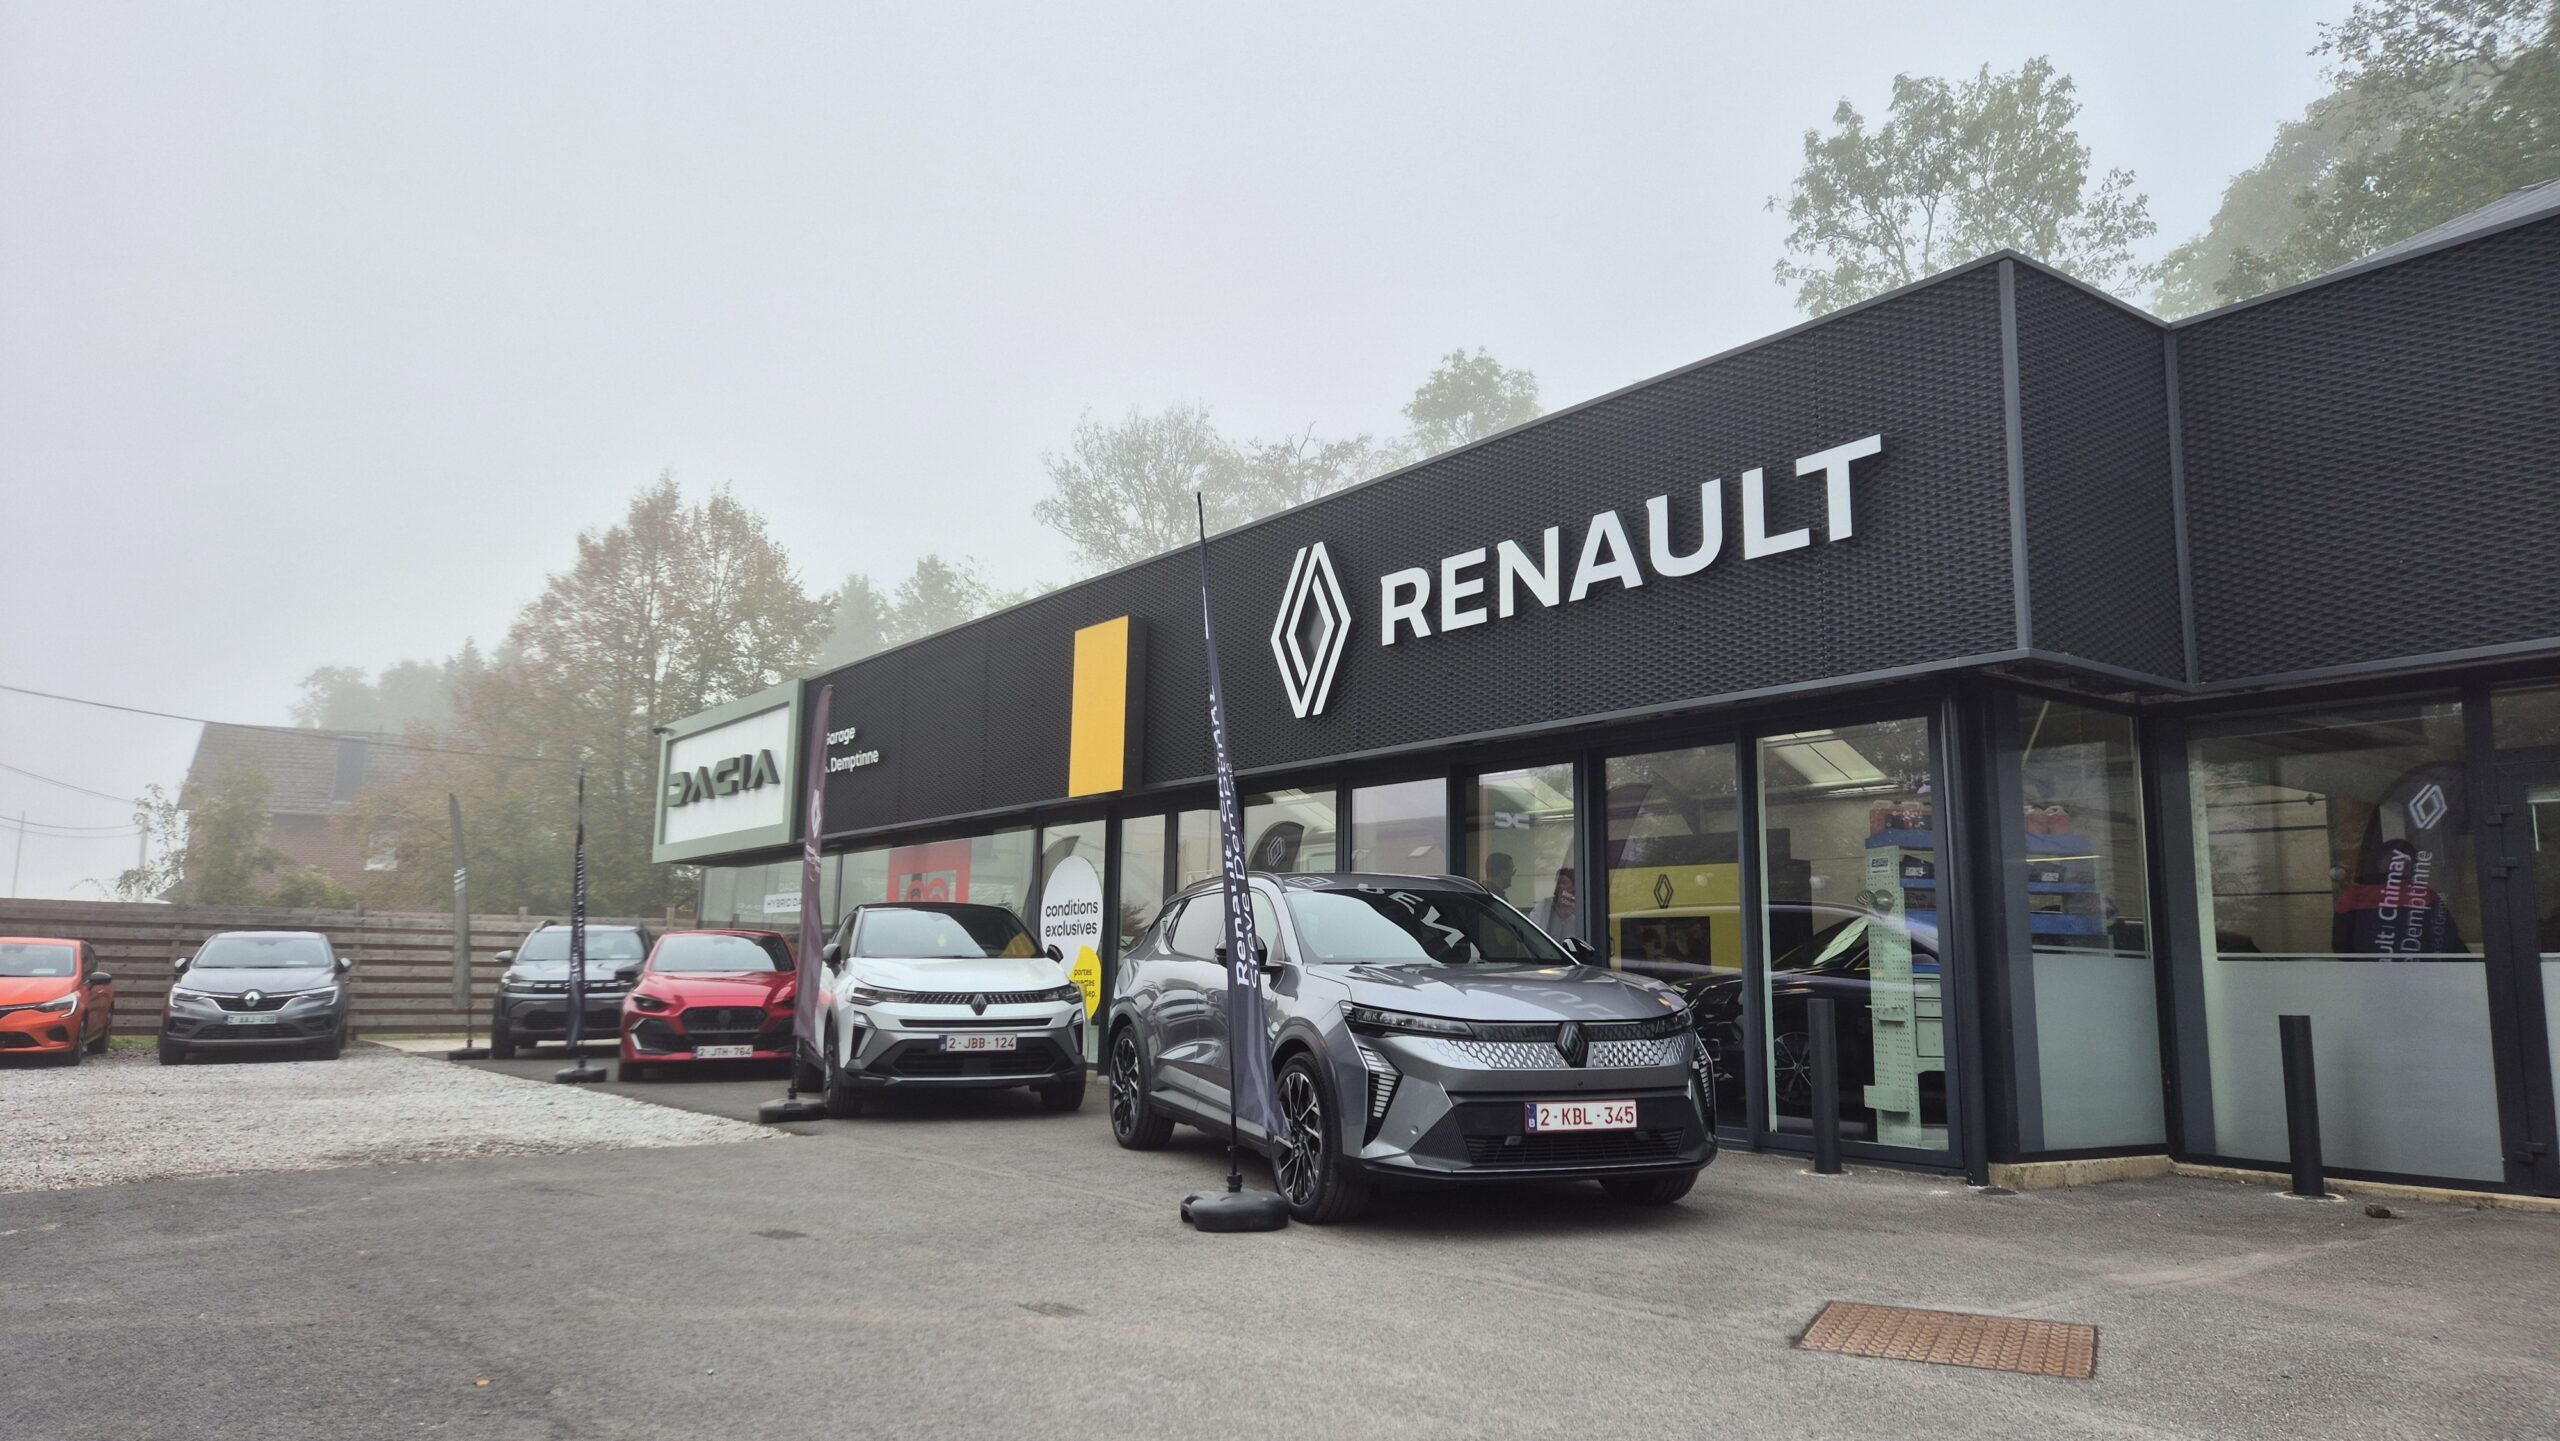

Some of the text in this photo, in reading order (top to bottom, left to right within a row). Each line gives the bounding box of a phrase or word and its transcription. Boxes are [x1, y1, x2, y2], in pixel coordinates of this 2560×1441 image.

[1381, 434, 1881, 646] RENAULT
[665, 748, 780, 807] DACIA
[830, 750, 879, 772] Demptinne
[1045, 899, 1098, 917] conditions
[2379, 849, 2411, 920] Chimay
[2400, 850, 2432, 951] Demptinne
[1045, 920, 1097, 937] exclusives
[1225, 845, 1249, 986] Renault
[1242, 893, 1258, 989] Steve
[949, 1037, 1014, 1049] 2-JBB-124
[1540, 1106, 1634, 1126] 2-KBL-345
